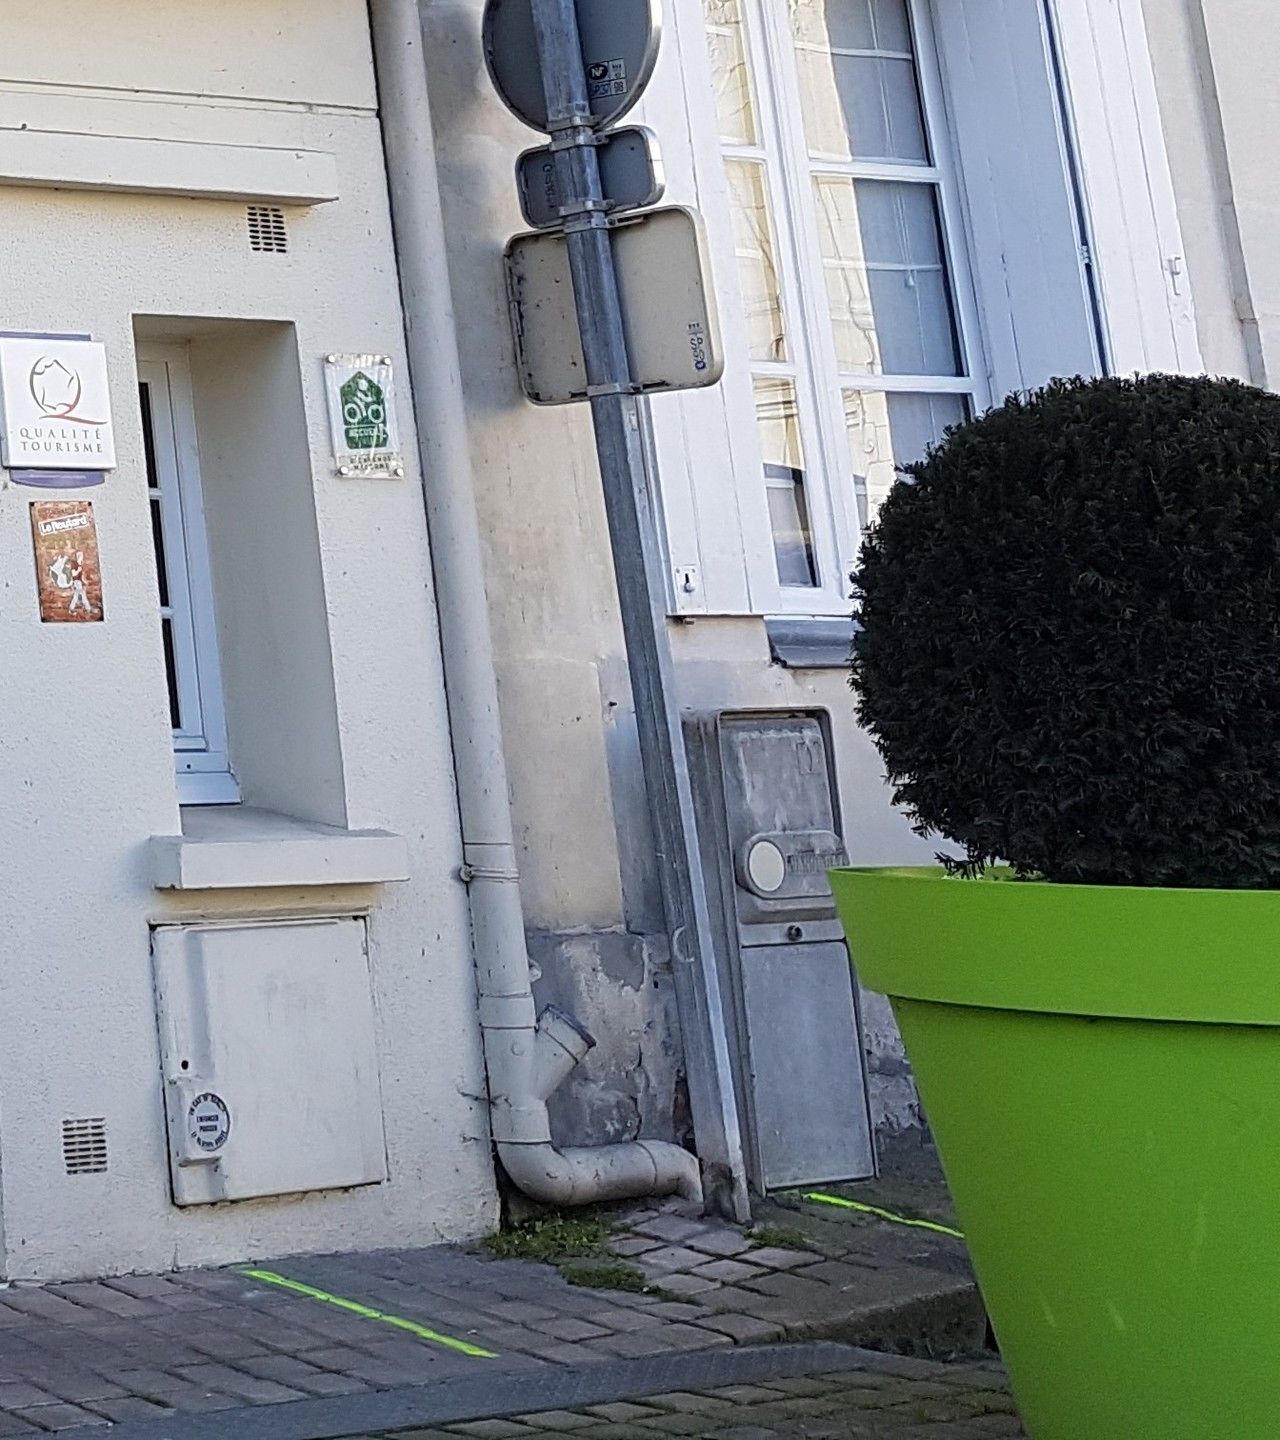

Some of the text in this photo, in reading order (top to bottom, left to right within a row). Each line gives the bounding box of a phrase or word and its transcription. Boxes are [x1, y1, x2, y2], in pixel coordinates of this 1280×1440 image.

[20, 427, 102, 440] QUALITÉ
[21, 441, 103, 453] TOURISME
[41, 520, 52, 533] Le
